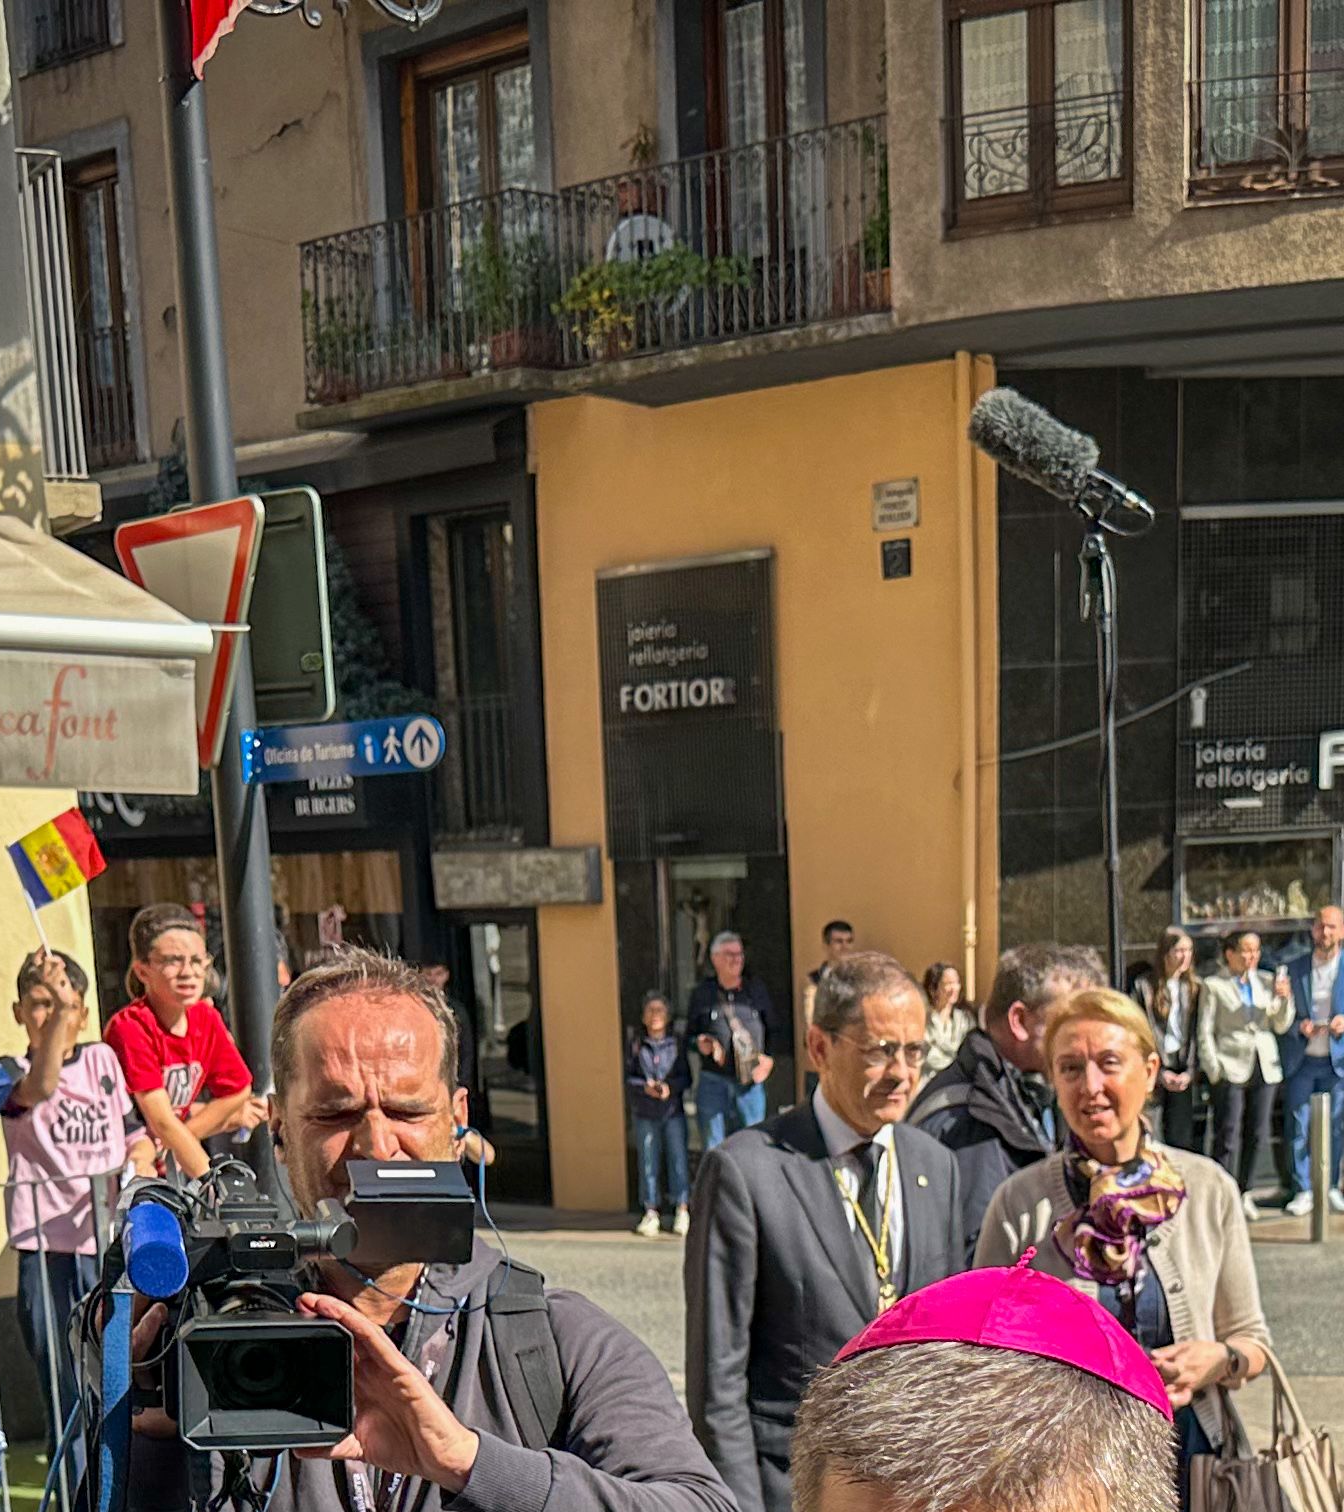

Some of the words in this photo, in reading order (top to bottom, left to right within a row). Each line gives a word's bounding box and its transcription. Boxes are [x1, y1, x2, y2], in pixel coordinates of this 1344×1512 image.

[620, 677, 727, 713] FORTIOR
[263, 746, 299, 766] Oficina
[299, 746, 314, 764] de
[314, 742, 355, 762] Turisme
[1195, 741, 1267, 769] joieria
